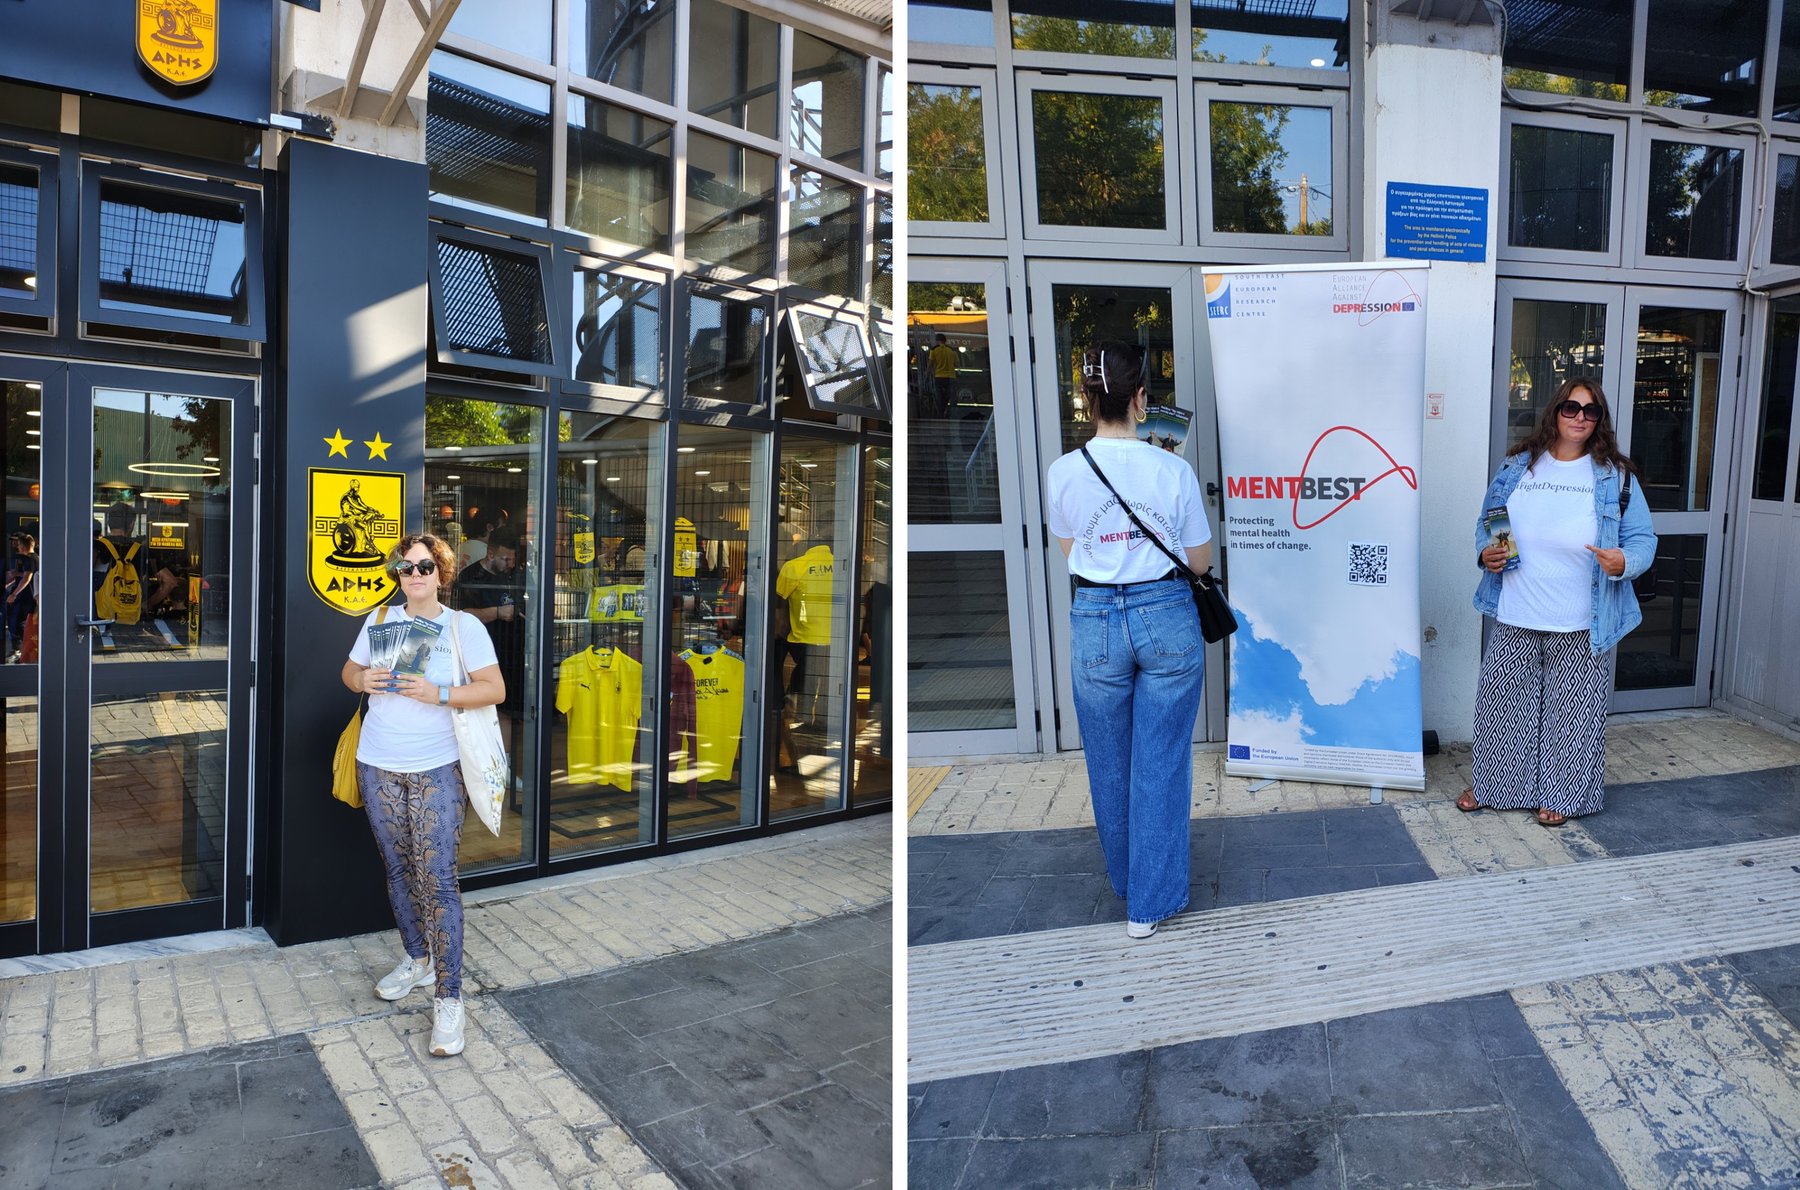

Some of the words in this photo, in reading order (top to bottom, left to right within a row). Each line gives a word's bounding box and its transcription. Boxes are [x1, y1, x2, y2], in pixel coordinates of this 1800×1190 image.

[1209, 306, 1229, 316] SEERC
[1333, 302, 1401, 313] DEPRESSION
[1227, 476, 1366, 501] MENTBEST
[1229, 516, 1275, 526] Protecting
[1083, 511, 1102, 558] νθίζουμε
[1124, 499, 1152, 516] ωρίς
[1152, 511, 1182, 557] κατάθλιψ
[1230, 528, 1260, 537] mental
[1261, 528, 1291, 537] health
[1230, 540, 1238, 549] in
[1239, 540, 1264, 549] times
[1266, 541, 1276, 549] of
[1276, 541, 1312, 552] change.
